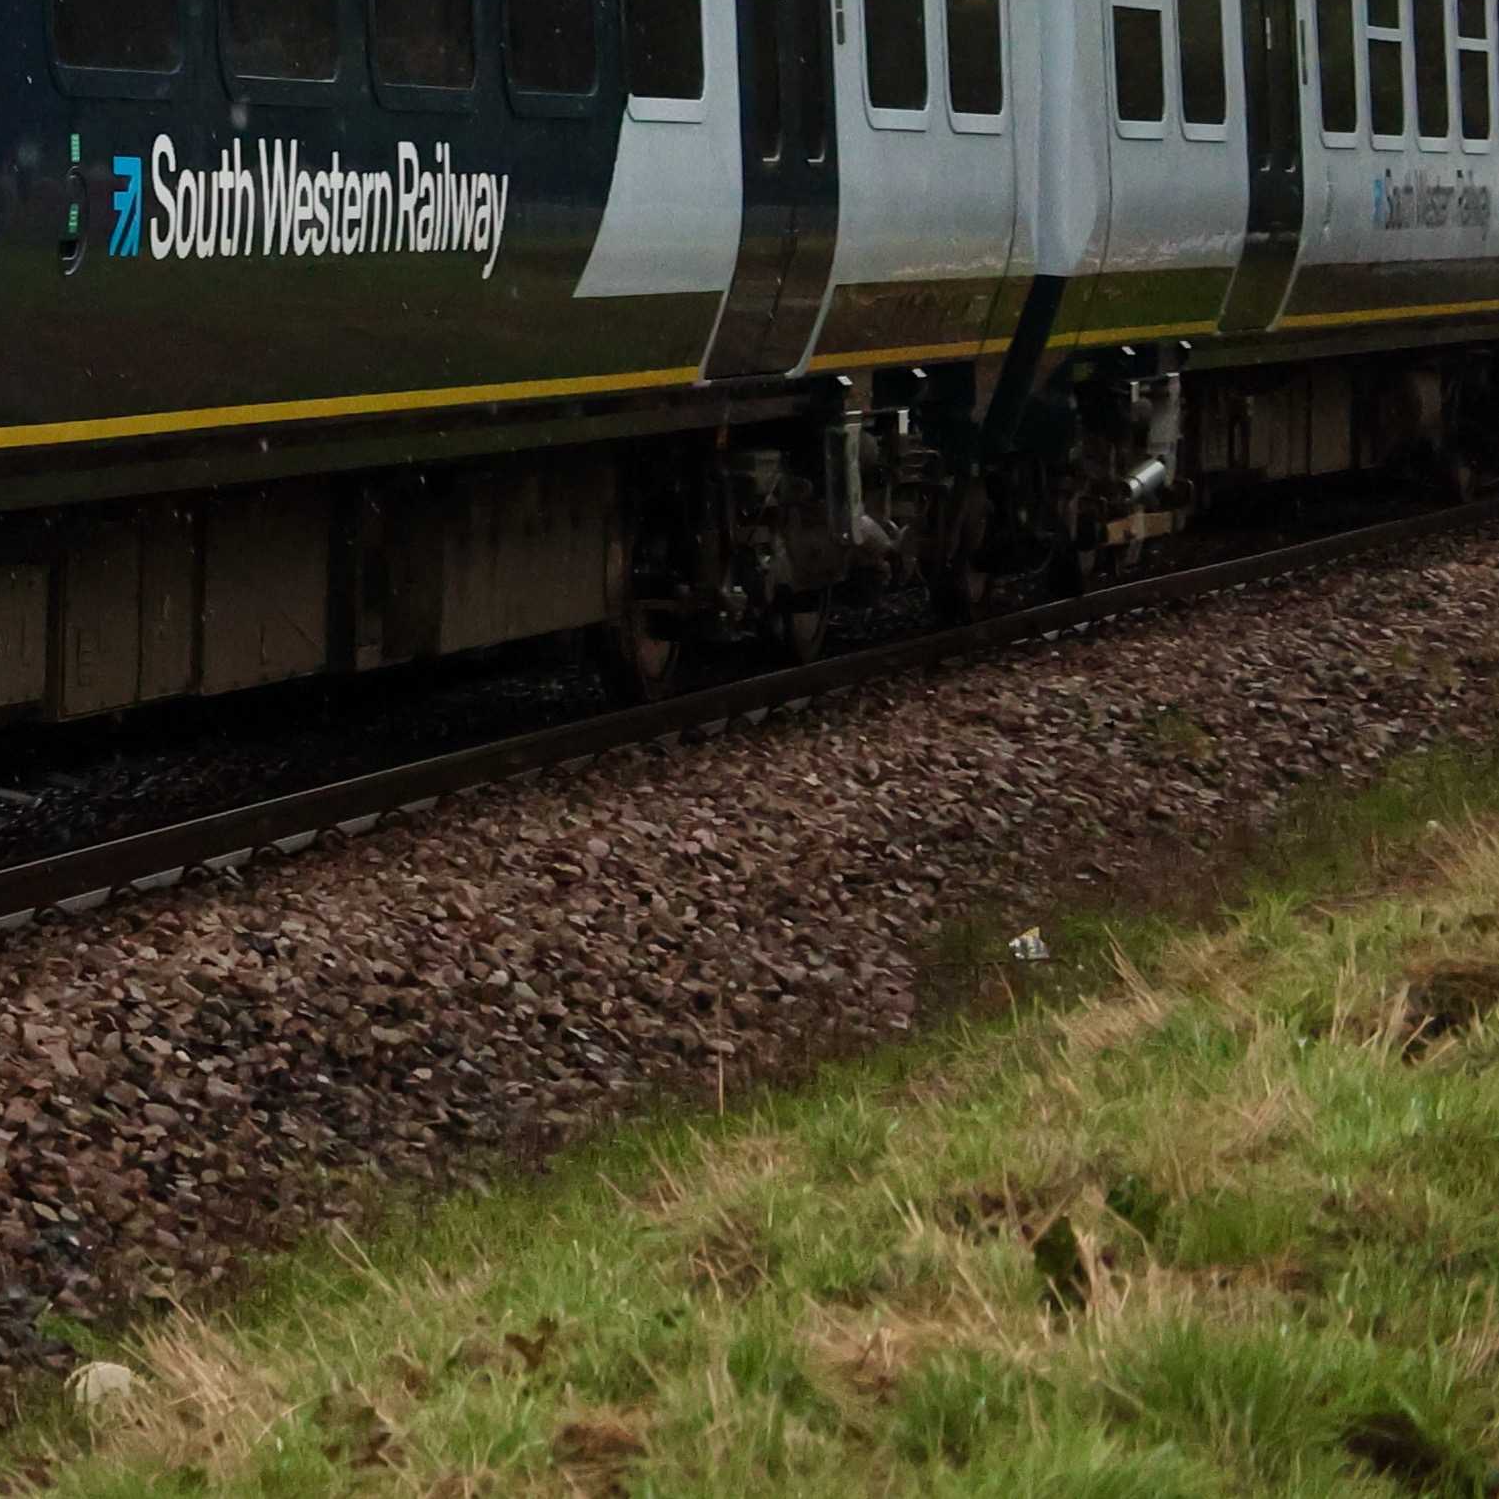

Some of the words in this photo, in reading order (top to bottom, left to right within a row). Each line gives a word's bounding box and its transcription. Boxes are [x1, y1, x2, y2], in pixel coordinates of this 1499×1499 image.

[149, 133, 257, 261] South
[258, 137, 394, 257] Western
[394, 140, 510, 280] Railway
